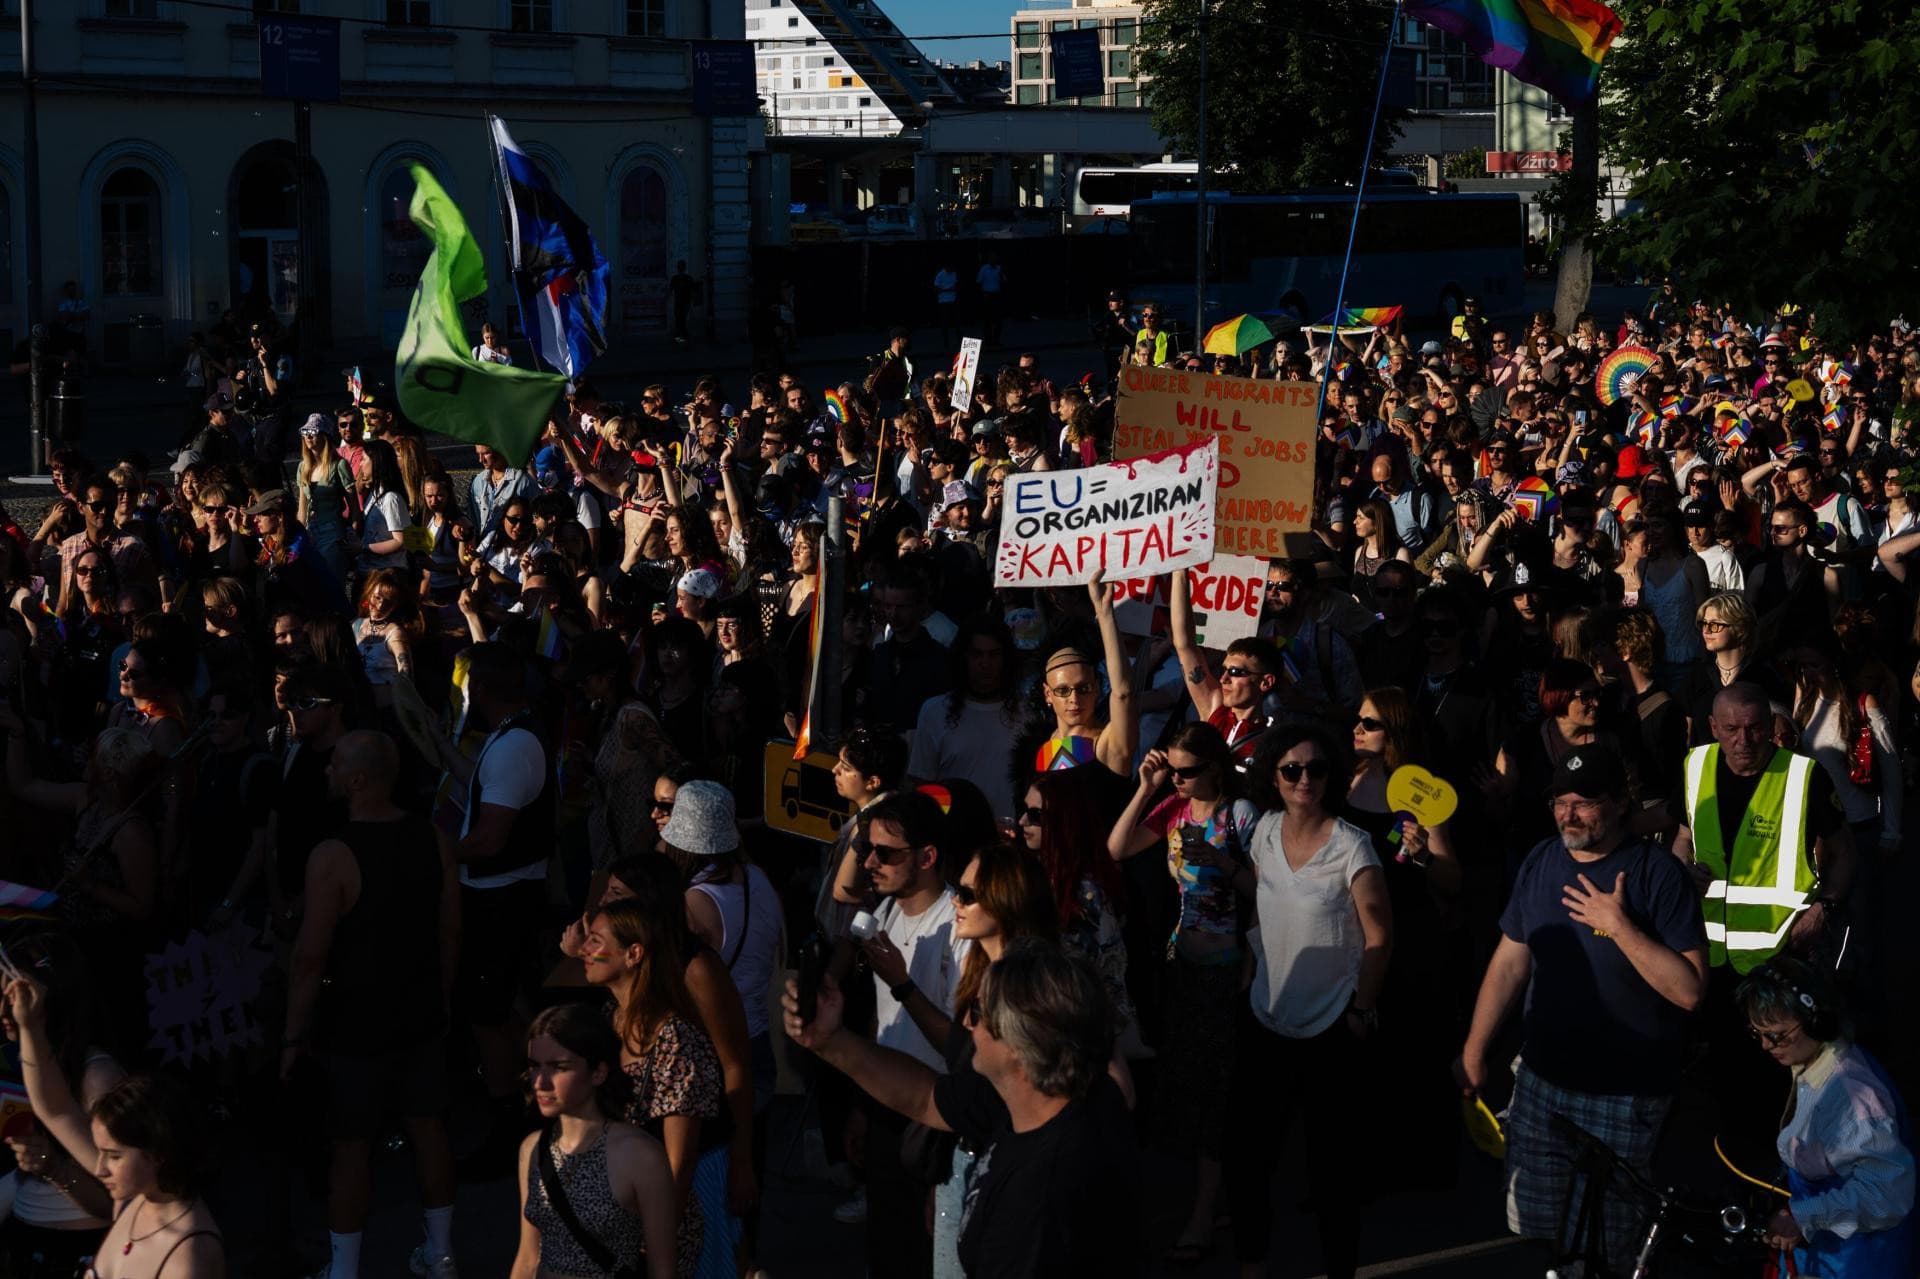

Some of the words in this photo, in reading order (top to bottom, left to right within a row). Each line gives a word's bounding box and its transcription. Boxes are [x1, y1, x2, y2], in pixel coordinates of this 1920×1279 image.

[263, 24, 284, 46] 12
[695, 51, 711, 70] 13
[1530, 155, 1558, 169] žito
[1125, 368, 1191, 394] QUEER
[1205, 379, 1315, 407] MIGRANTS
[1177, 401, 1251, 431] WILL
[1245, 437, 1307, 463] JOBS
[1015, 477, 1202, 539] ORGANIZIRAN
[1019, 516, 1191, 580] KAPITAL
